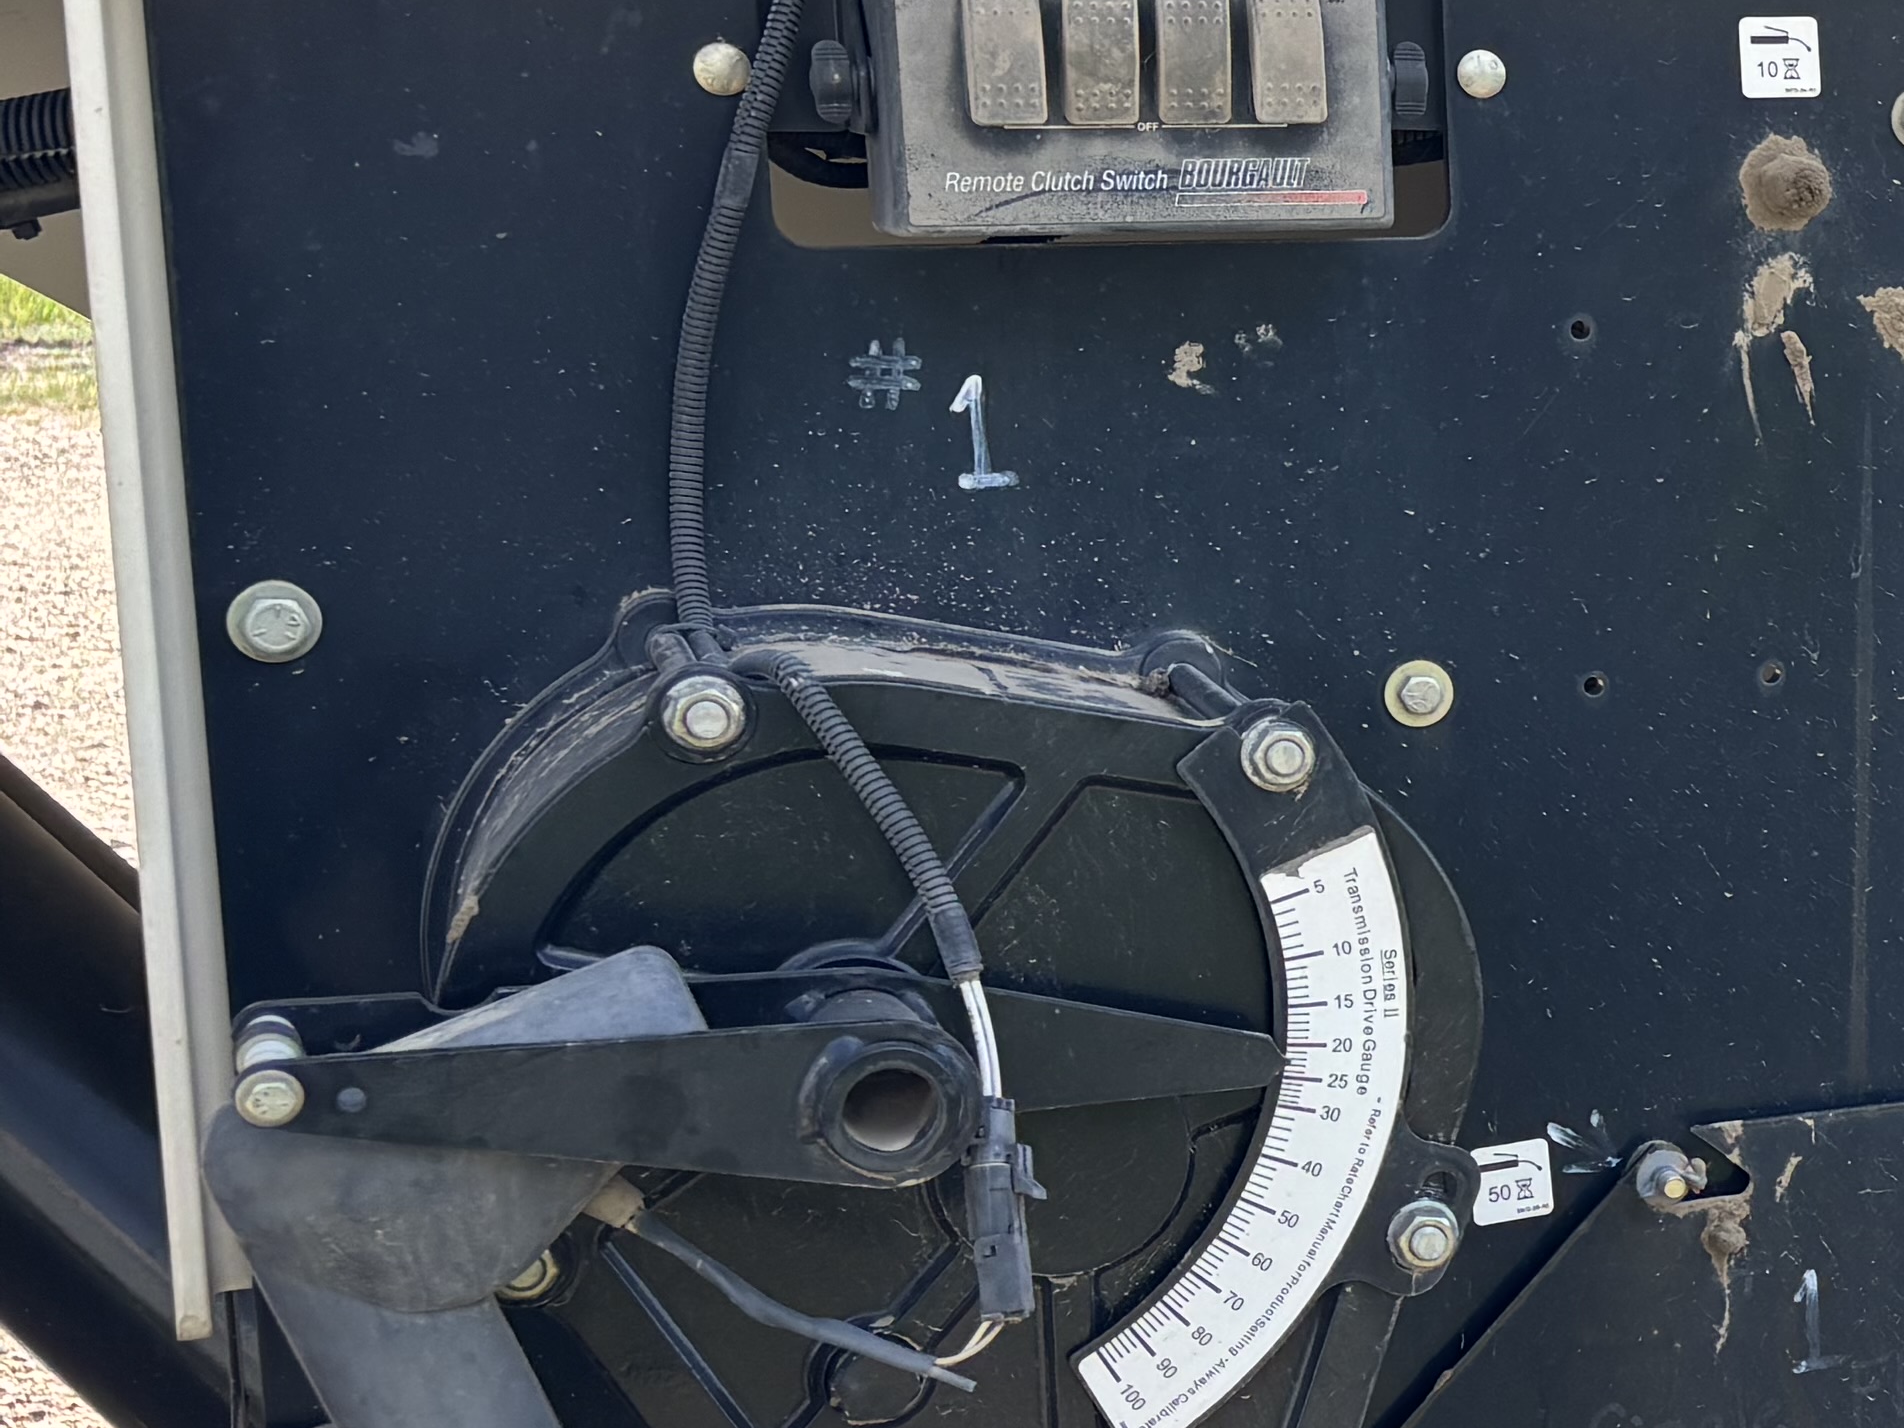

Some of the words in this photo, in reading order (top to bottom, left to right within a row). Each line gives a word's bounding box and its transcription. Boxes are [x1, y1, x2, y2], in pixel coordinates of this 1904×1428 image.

[1757, 61, 1778, 78] 10
[1136, 122, 1159, 132] OFF
[945, 172, 1025, 193] Remote
[1031, 171, 1095, 192] Clutch
[1100, 170, 1168, 191] Switch
[1178, 157, 1311, 190] BOURGAULT
[1313, 880, 1325, 894] 5
[1344, 868, 1374, 985] Transmission
[1333, 941, 1352, 956] 10
[1381, 948, 1398, 1002] Series
[1334, 995, 1354, 1010] 15
[1361, 988, 1378, 1036] Drive
[1332, 1038, 1353, 1053] 20
[1356, 1038, 1377, 1096] Gauge
[1327, 1074, 1348, 1089] 25
[1320, 1106, 1341, 1122] 30
[1362, 1109, 1381, 1142] Refer
[1357, 1141, 1368, 1155] to
[1301, 1160, 1323, 1178] 40
[1346, 1156, 1365, 1186] Rate
[1329, 1186, 1353, 1222] Chart
[1488, 1184, 1512, 1203] 50
[1277, 1209, 1300, 1229] 50
[1308, 1218, 1338, 1259] Manual
[1251, 1252, 1273, 1272] 60
[1293, 1256, 1311, 1280] for
[1223, 1291, 1245, 1311] 70
[1265, 1272, 1300, 1322] Product
[1793, 1268, 1850, 1374] 1
[1191, 1326, 1213, 1347] 80
[1228, 1317, 1266, 1358] Setting
[1156, 1357, 1178, 1380] 90
[1190, 1357, 1227, 1397] Always
[1120, 1383, 1146, 1411] 100
